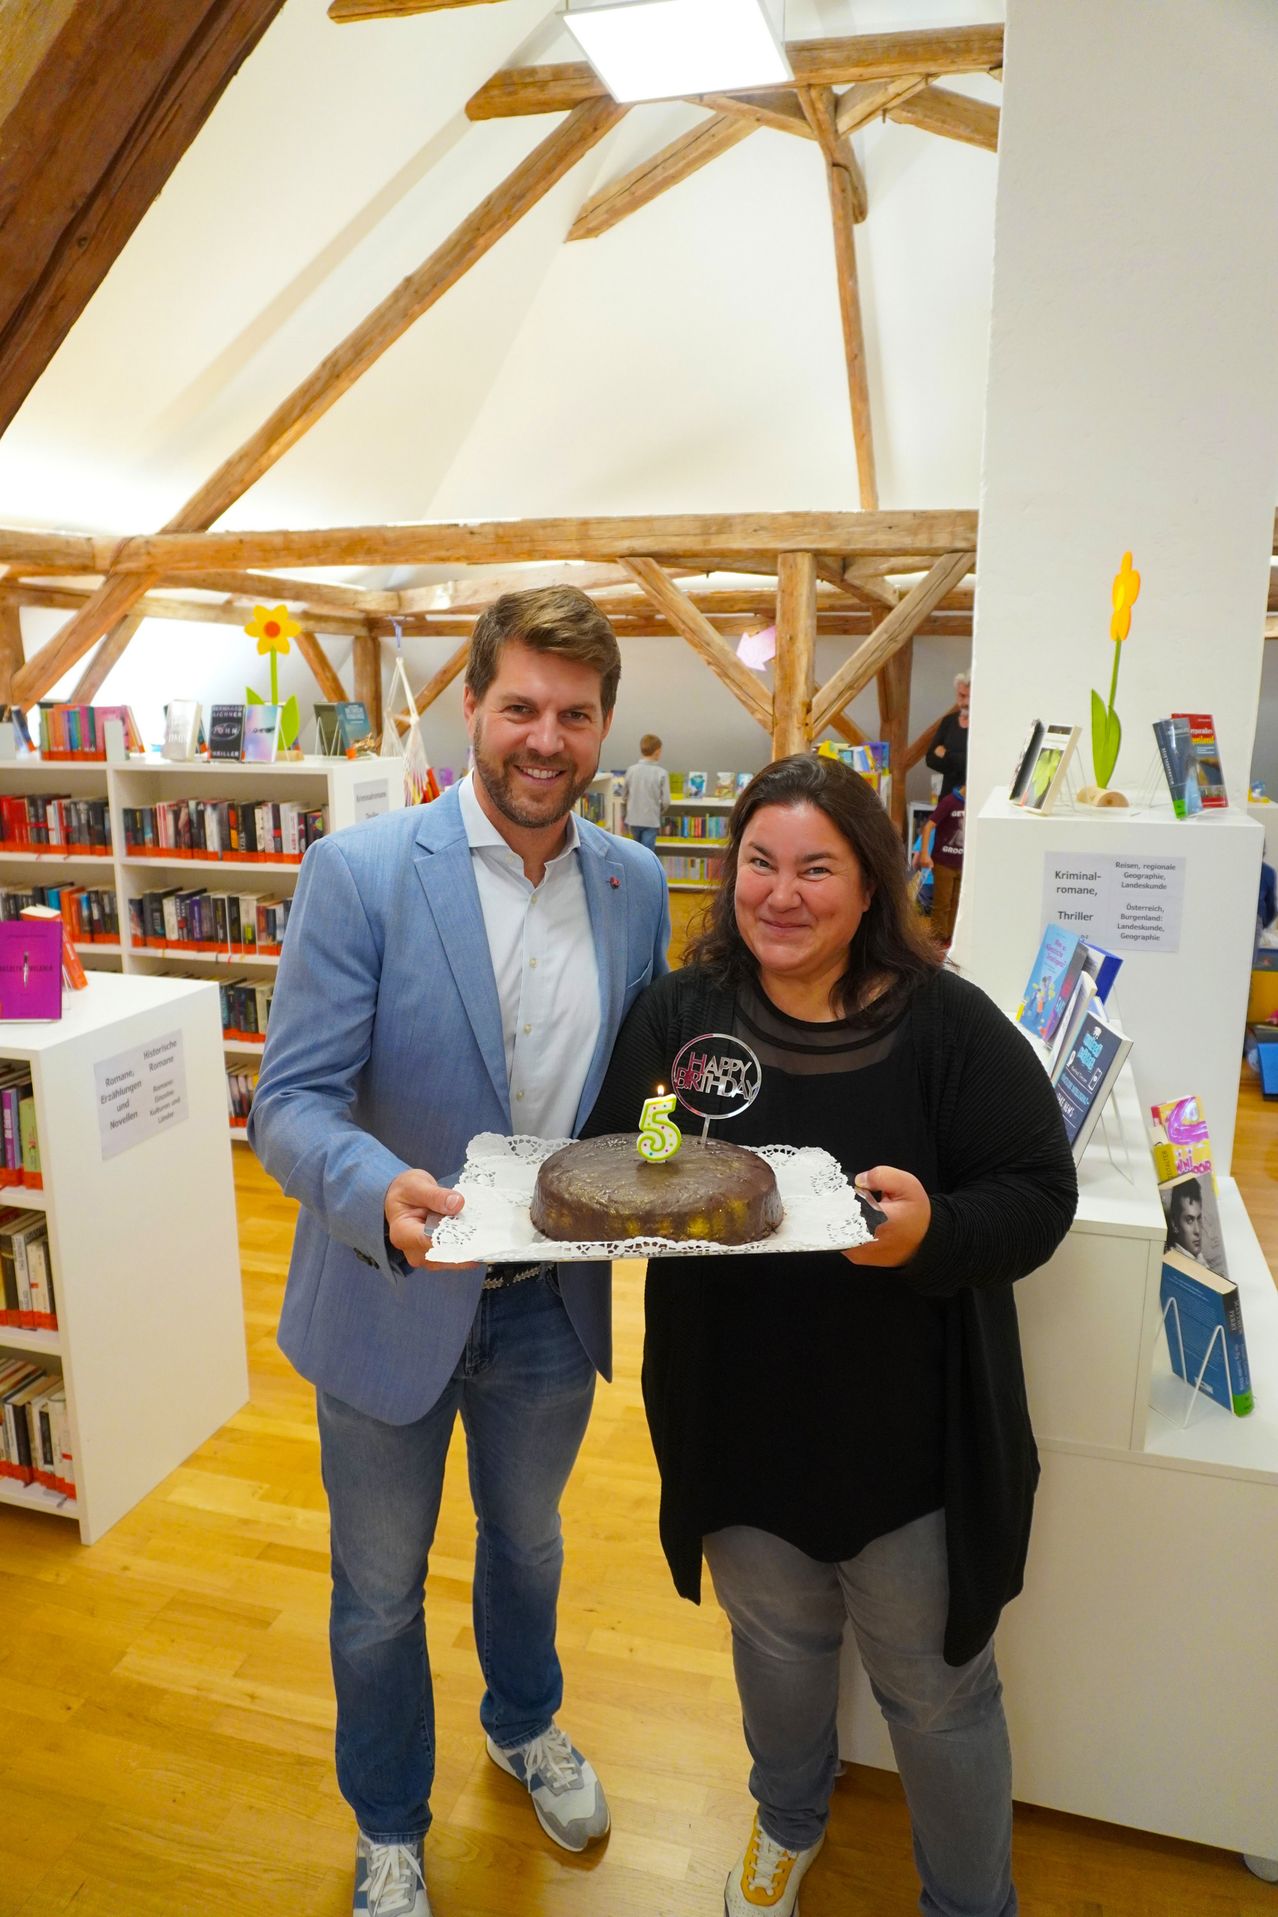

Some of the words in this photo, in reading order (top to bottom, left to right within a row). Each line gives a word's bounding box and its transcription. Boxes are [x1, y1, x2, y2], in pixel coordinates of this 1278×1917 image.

[1115, 861, 1141, 871] Reisen,
[1143, 863, 1176, 872] regionale
[1055, 870, 1101, 881] Kriminal-
[1123, 871, 1166, 881] Geographie,
[1121, 881, 1167, 890] Landeskunde
[1056, 886, 1098, 897] romane,
[1126, 902, 1165, 913] Österreich,
[1058, 910, 1094, 921] Thriller
[1120, 913, 1163, 923] Burgenland:
[1117, 922, 1165, 933] Landeskunde,
[1120, 932, 1160, 942] Geographie
[143, 1040, 177, 1060] Historische
[148, 1056, 174, 1072] Romane
[688, 1051, 752, 1081] HAPPY
[105, 1070, 135, 1088] Romane,
[100, 1080, 142, 1105] Erzählungen
[116, 1098, 130, 1113] und
[109, 1111, 138, 1130] Novellen
